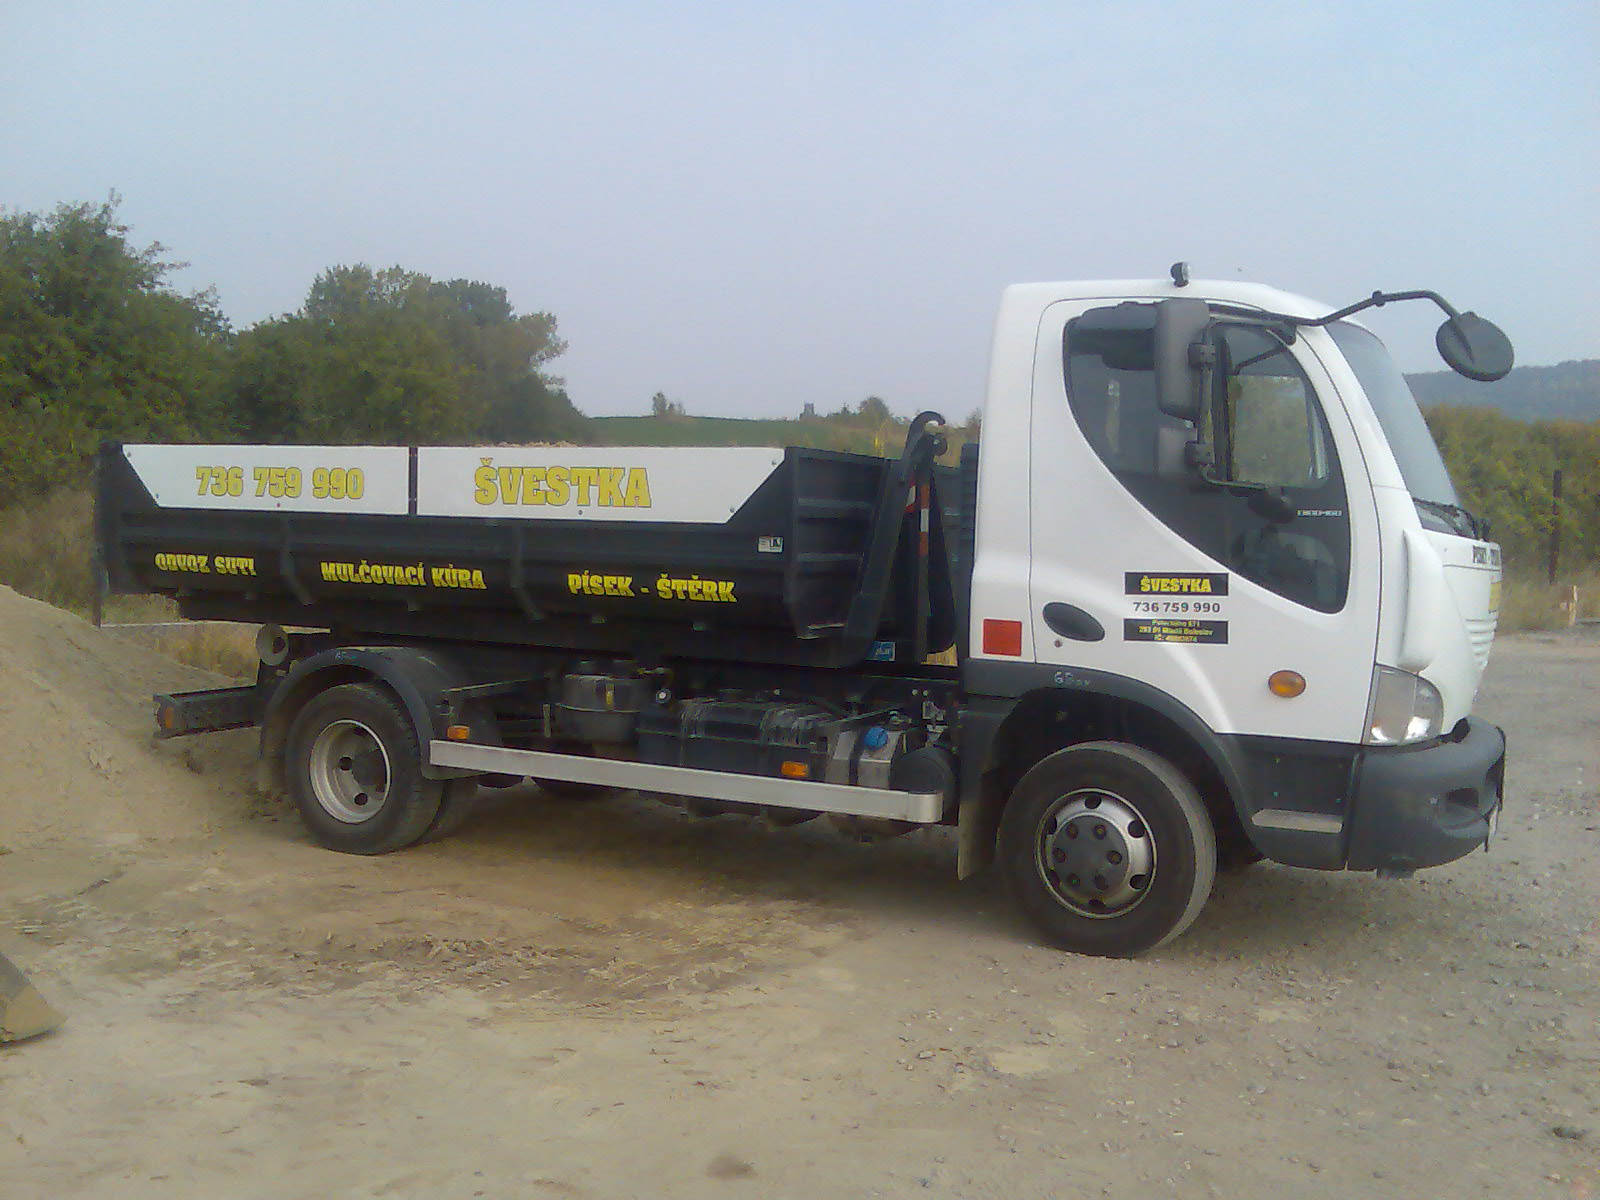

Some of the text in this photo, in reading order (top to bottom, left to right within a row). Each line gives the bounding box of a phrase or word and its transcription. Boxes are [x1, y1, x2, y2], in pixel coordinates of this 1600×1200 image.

[195, 465, 365, 499] 736 759 990
[474, 457, 652, 509] ŠVESTKA
[155, 552, 257, 577] ODVOZ SUTI
[320, 559, 427, 587] MULČOVACÍ
[567, 569, 636, 598] PÍSEK
[656, 573, 738, 603] ŠTĚRK
[1140, 575, 1212, 593] ŠVESTKA
[1133, 602, 1221, 613] 736 759 990
